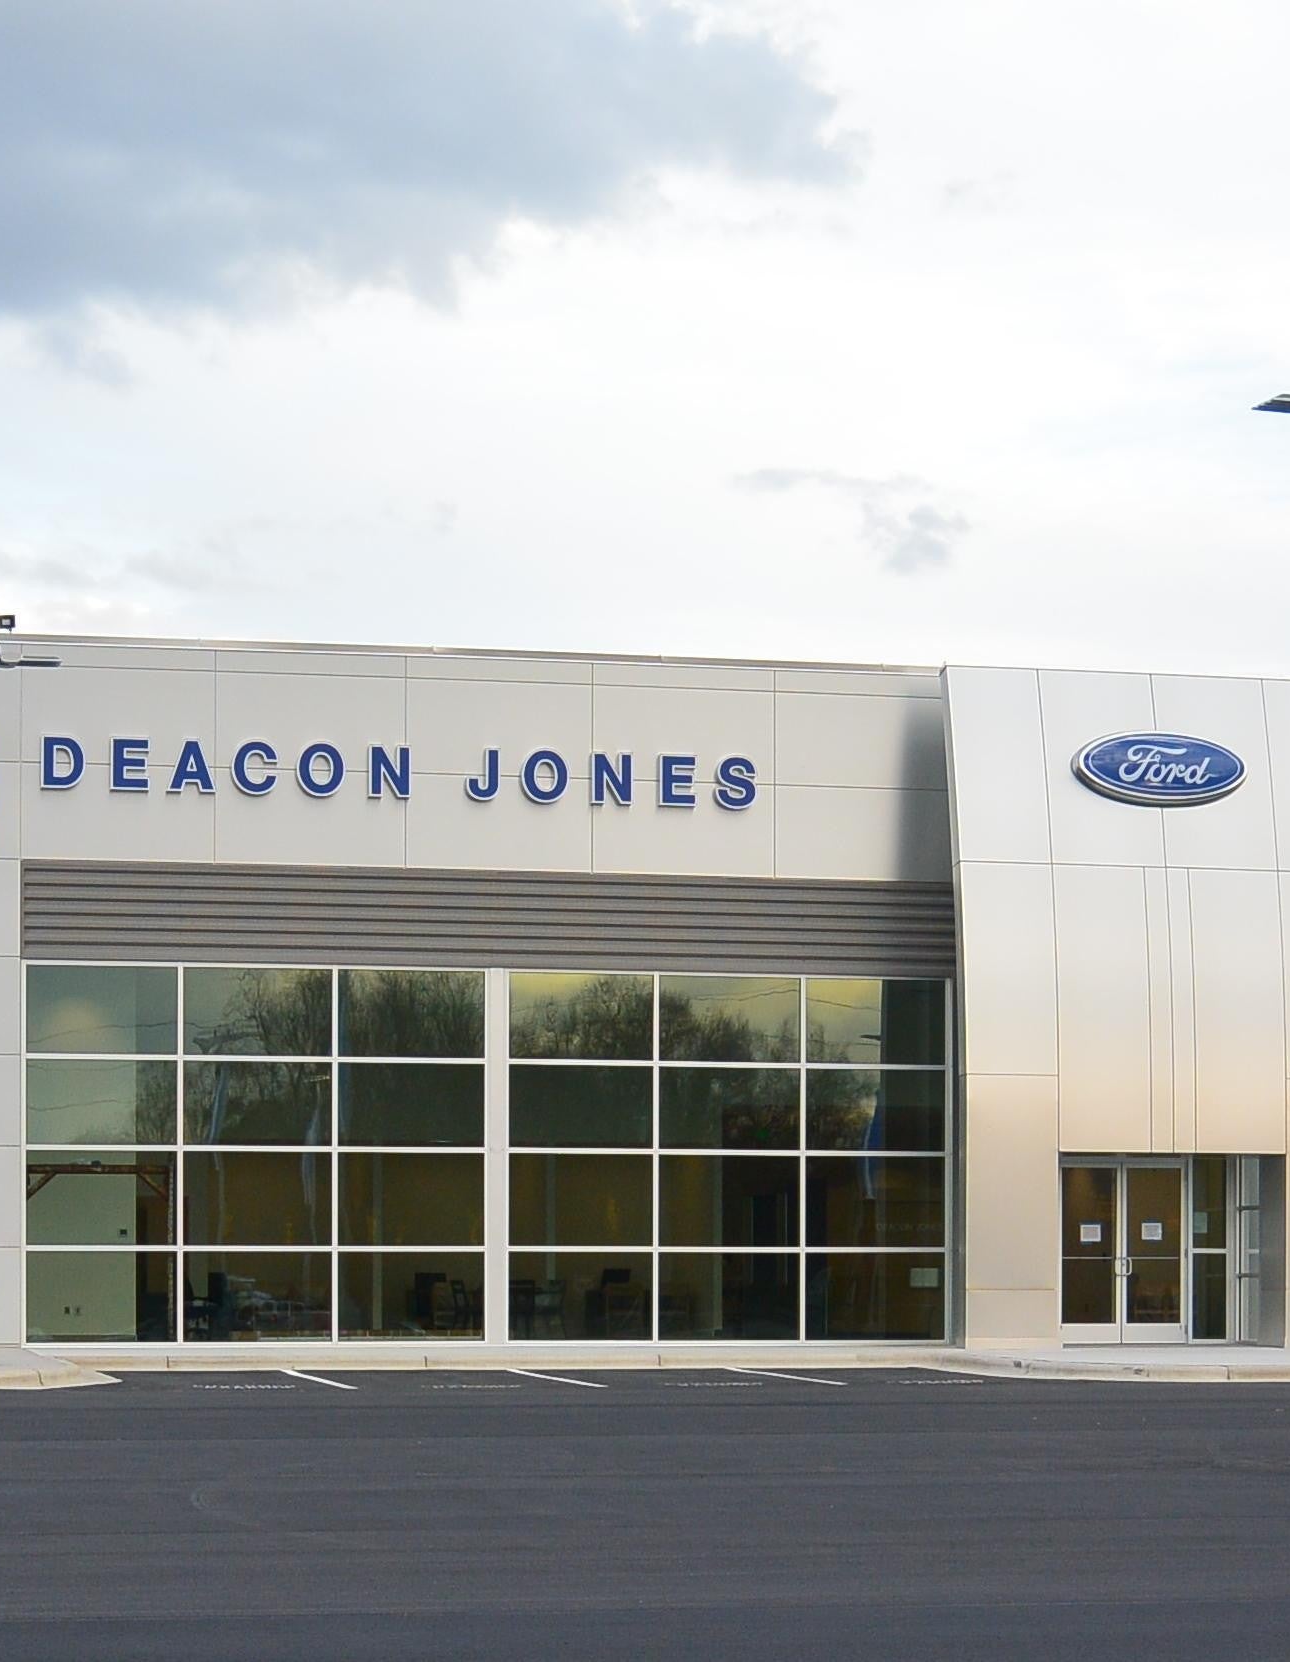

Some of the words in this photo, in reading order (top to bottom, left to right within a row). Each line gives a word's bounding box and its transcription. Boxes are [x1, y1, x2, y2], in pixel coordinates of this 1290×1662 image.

[39, 734, 411, 799] DEACON
[466, 746, 758, 810] JONES
[1118, 744, 1218, 785] Ford
